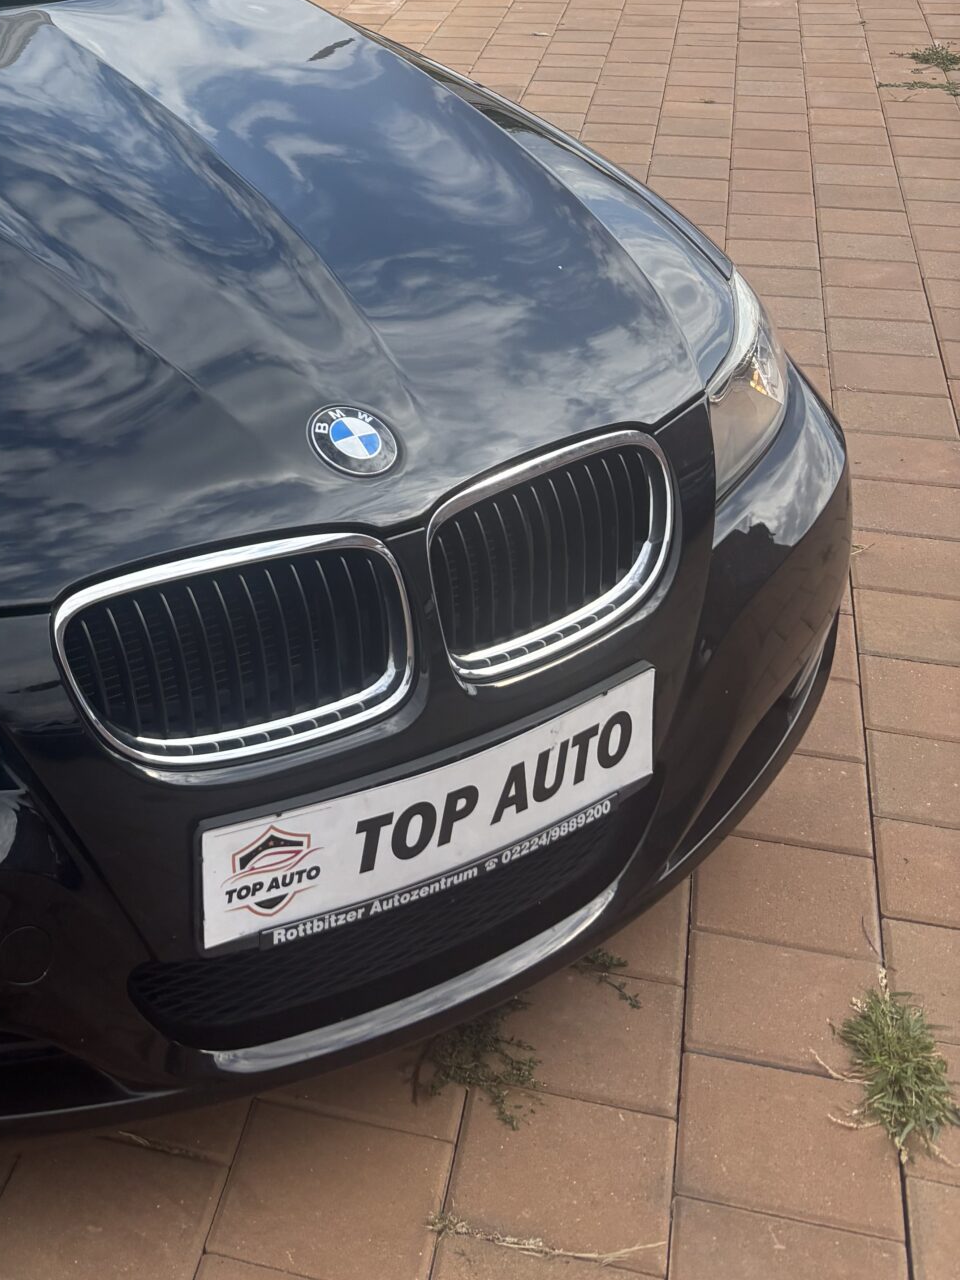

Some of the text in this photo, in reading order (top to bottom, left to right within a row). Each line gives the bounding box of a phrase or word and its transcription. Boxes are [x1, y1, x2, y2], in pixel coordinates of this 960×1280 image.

[314, 408, 374, 435] BMW
[355, 710, 634, 874] TOP AUTO
[224, 865, 321, 905] TOP AUTO
[272, 799, 612, 946] Rottbitzer Autozentrum 02224/9889200
